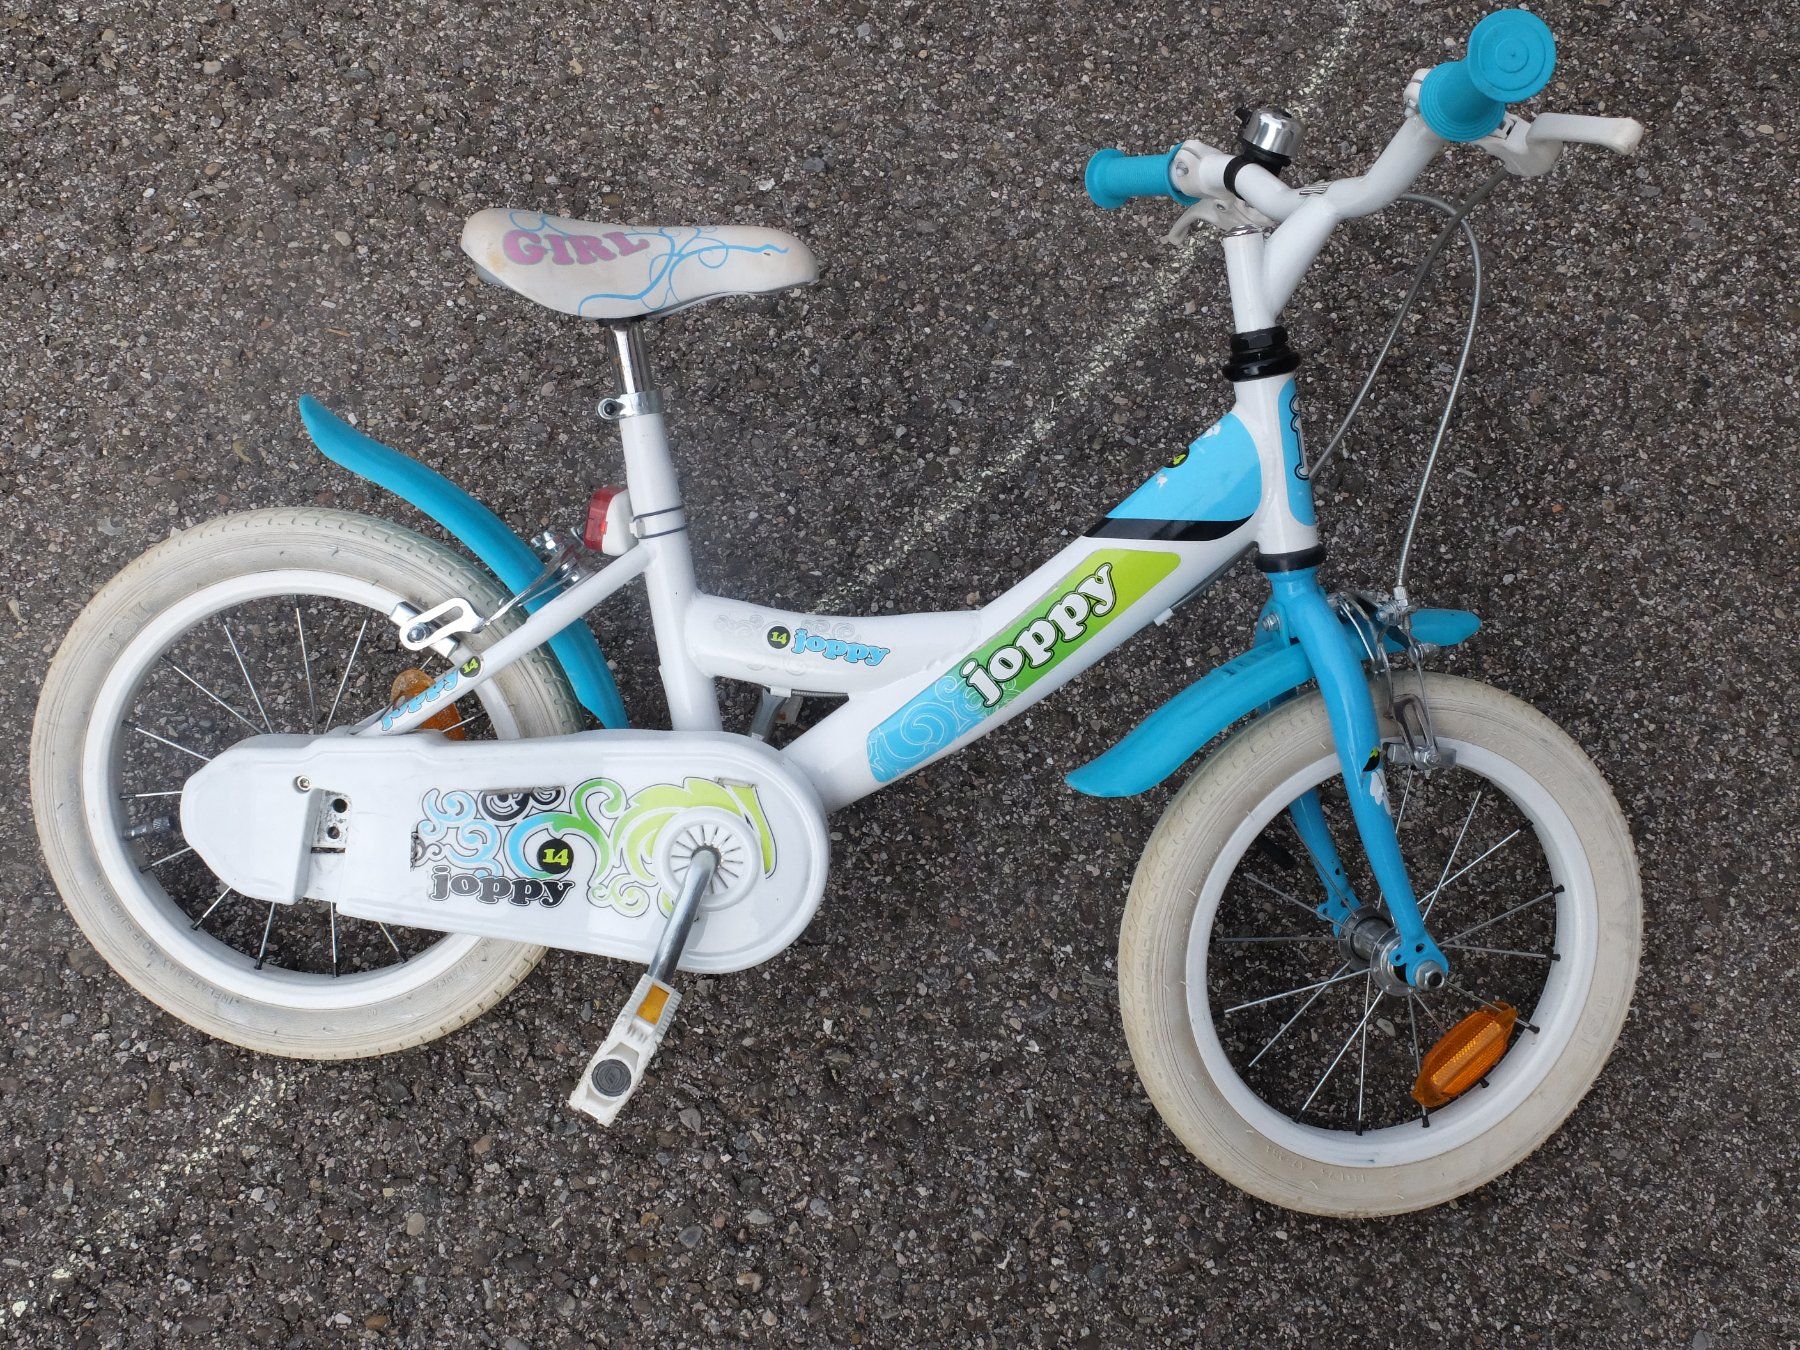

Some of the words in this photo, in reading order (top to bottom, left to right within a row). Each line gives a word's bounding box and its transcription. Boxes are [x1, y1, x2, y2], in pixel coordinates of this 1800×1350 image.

[502, 229, 650, 266] GIRL
[770, 631, 788, 645] 14
[790, 627, 891, 667] joppy
[958, 561, 1117, 708] joppy
[462, 657, 480, 674] 14
[542, 847, 569, 867] 14
[428, 864, 576, 908] joppy
